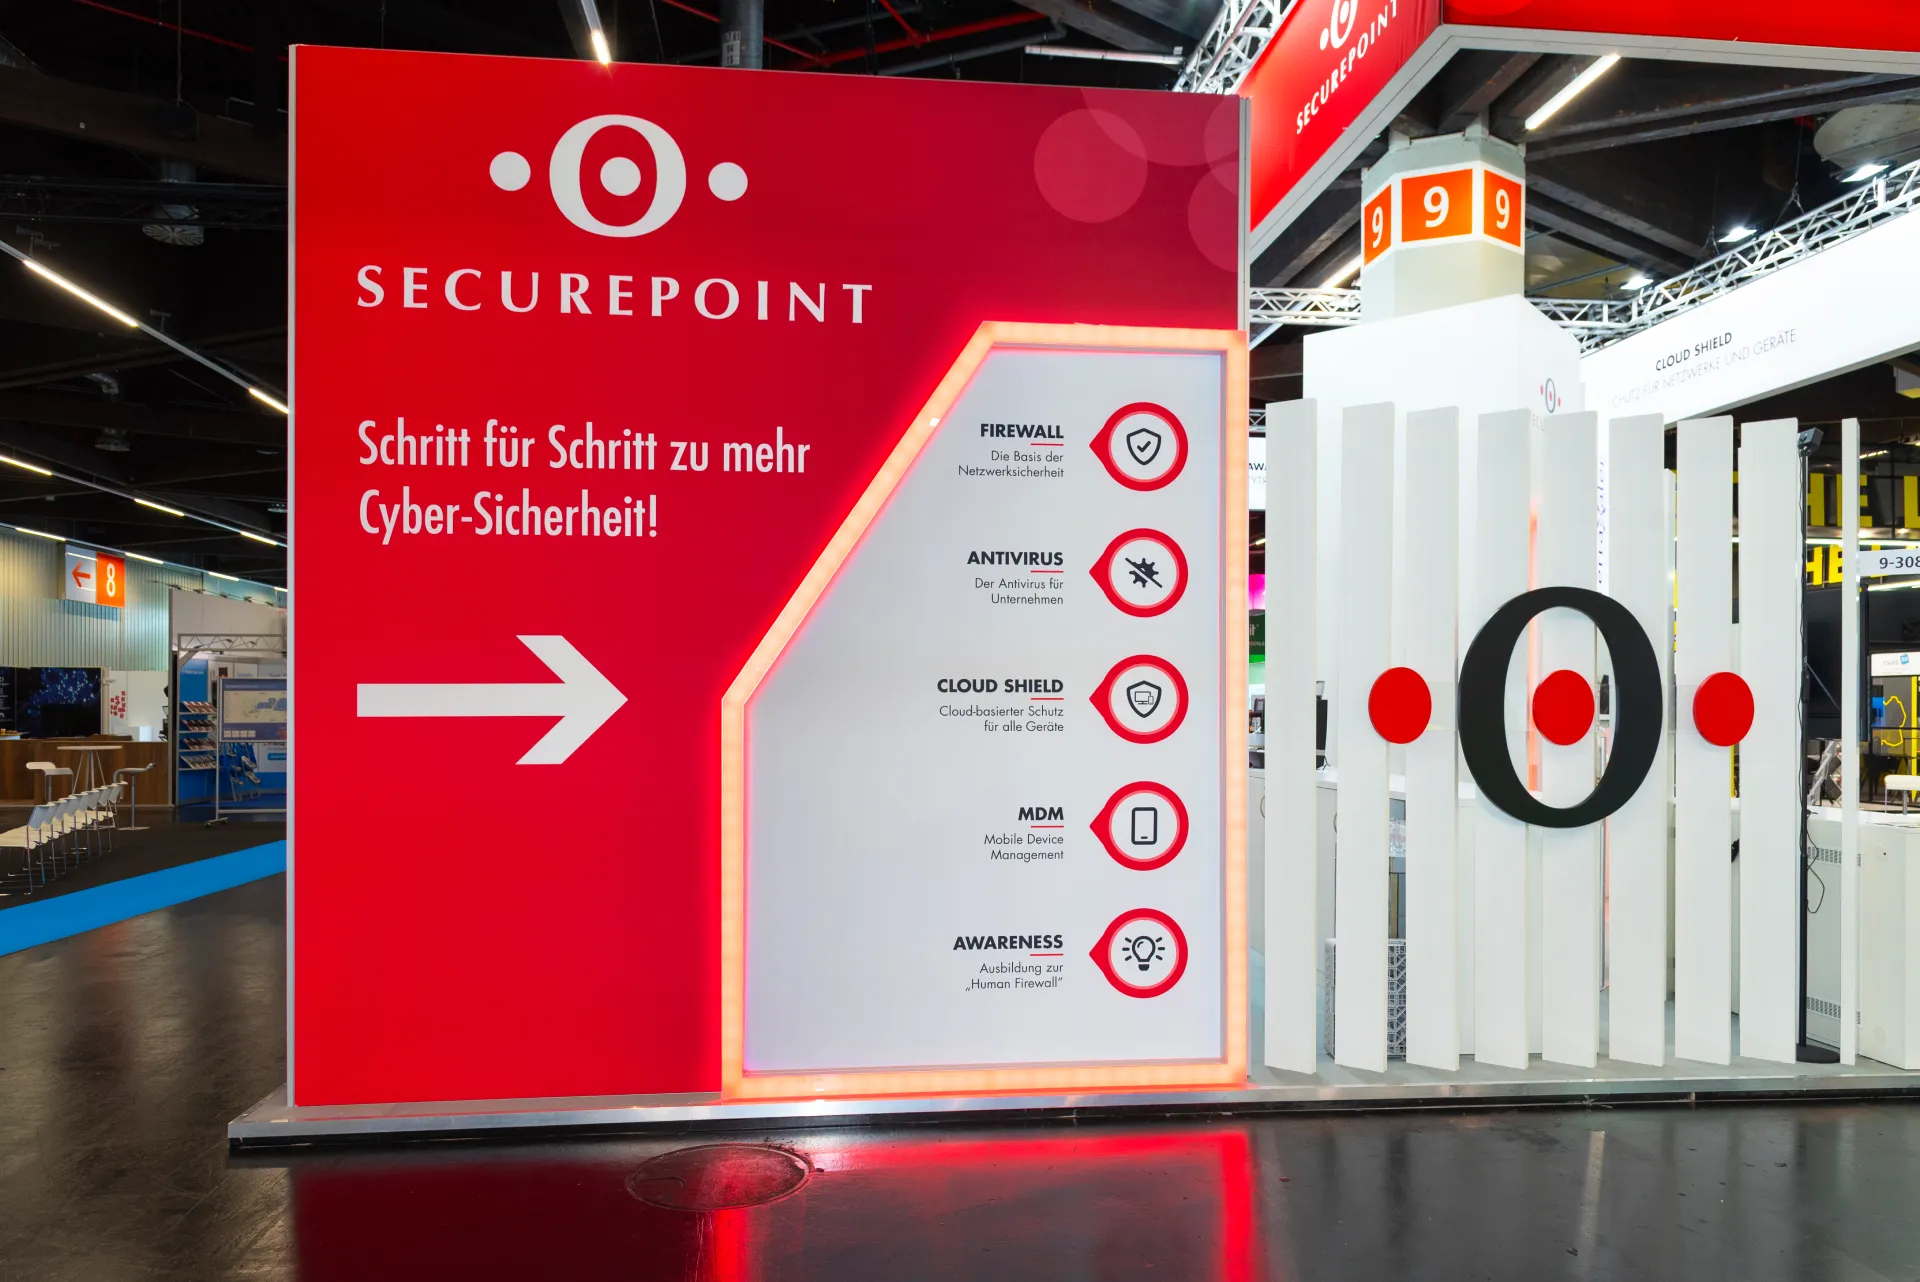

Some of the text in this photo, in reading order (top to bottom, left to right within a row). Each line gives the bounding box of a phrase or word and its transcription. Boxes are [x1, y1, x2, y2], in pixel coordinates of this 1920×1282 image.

[1423, 185, 1450, 228] 9
[1495, 189, 1510, 230] 9
[1372, 206, 1384, 249] 9
[358, 265, 873, 324] SECUREPOINT
[1655, 332, 1733, 372] CLOUD SHIELD
[1725, 346, 1751, 367] UND
[980, 423, 1065, 439] FIREWALL
[358, 416, 811, 473] Schritt für Schritt zu mehr
[991, 450, 1064, 462] Die Basis der
[958, 465, 1065, 478] Netzwerksicherheit
[359, 486, 658, 545] Cyber-Sicherheit!
[966, 551, 1064, 566] ANTIVIRUS
[106, 563, 116, 597] 8
[974, 578, 1064, 590] Der Antivirus für
[991, 593, 1064, 605] Unternehmen
[936, 678, 1064, 694] CLOUD SHIELD
[939, 705, 1064, 717] Cloud-basierter Schutz
[984, 720, 1064, 732] für alle Geräte
[1018, 807, 1064, 821] MDM
[983, 833, 1064, 845] Mobile Device
[990, 850, 1064, 863] Management
[952, 934, 1064, 951] AWARENESS
[979, 961, 1064, 975] Ausbildung zur
[965, 979, 1011, 992] „Human
